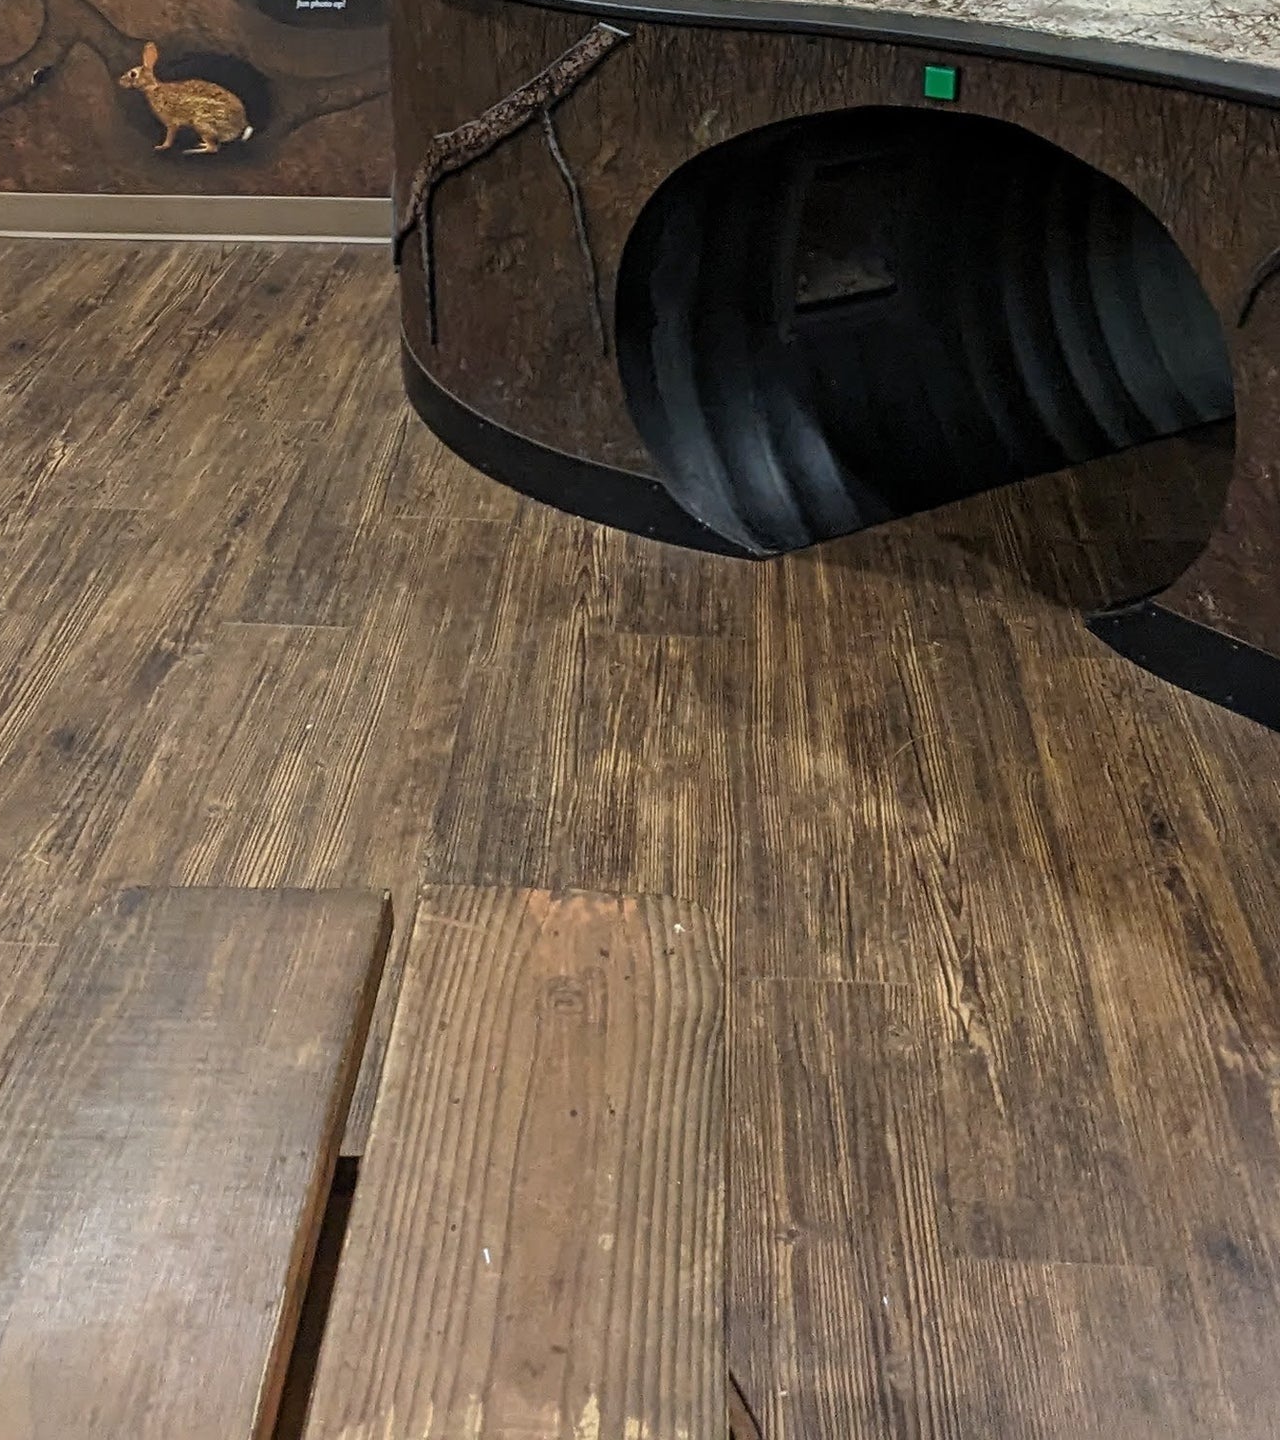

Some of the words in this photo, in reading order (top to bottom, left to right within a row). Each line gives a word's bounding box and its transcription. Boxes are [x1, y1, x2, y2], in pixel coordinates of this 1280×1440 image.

[296, 0, 309, 9] fun
[310, 0, 332, 9] photo
[334, 0, 346, 9] op!
